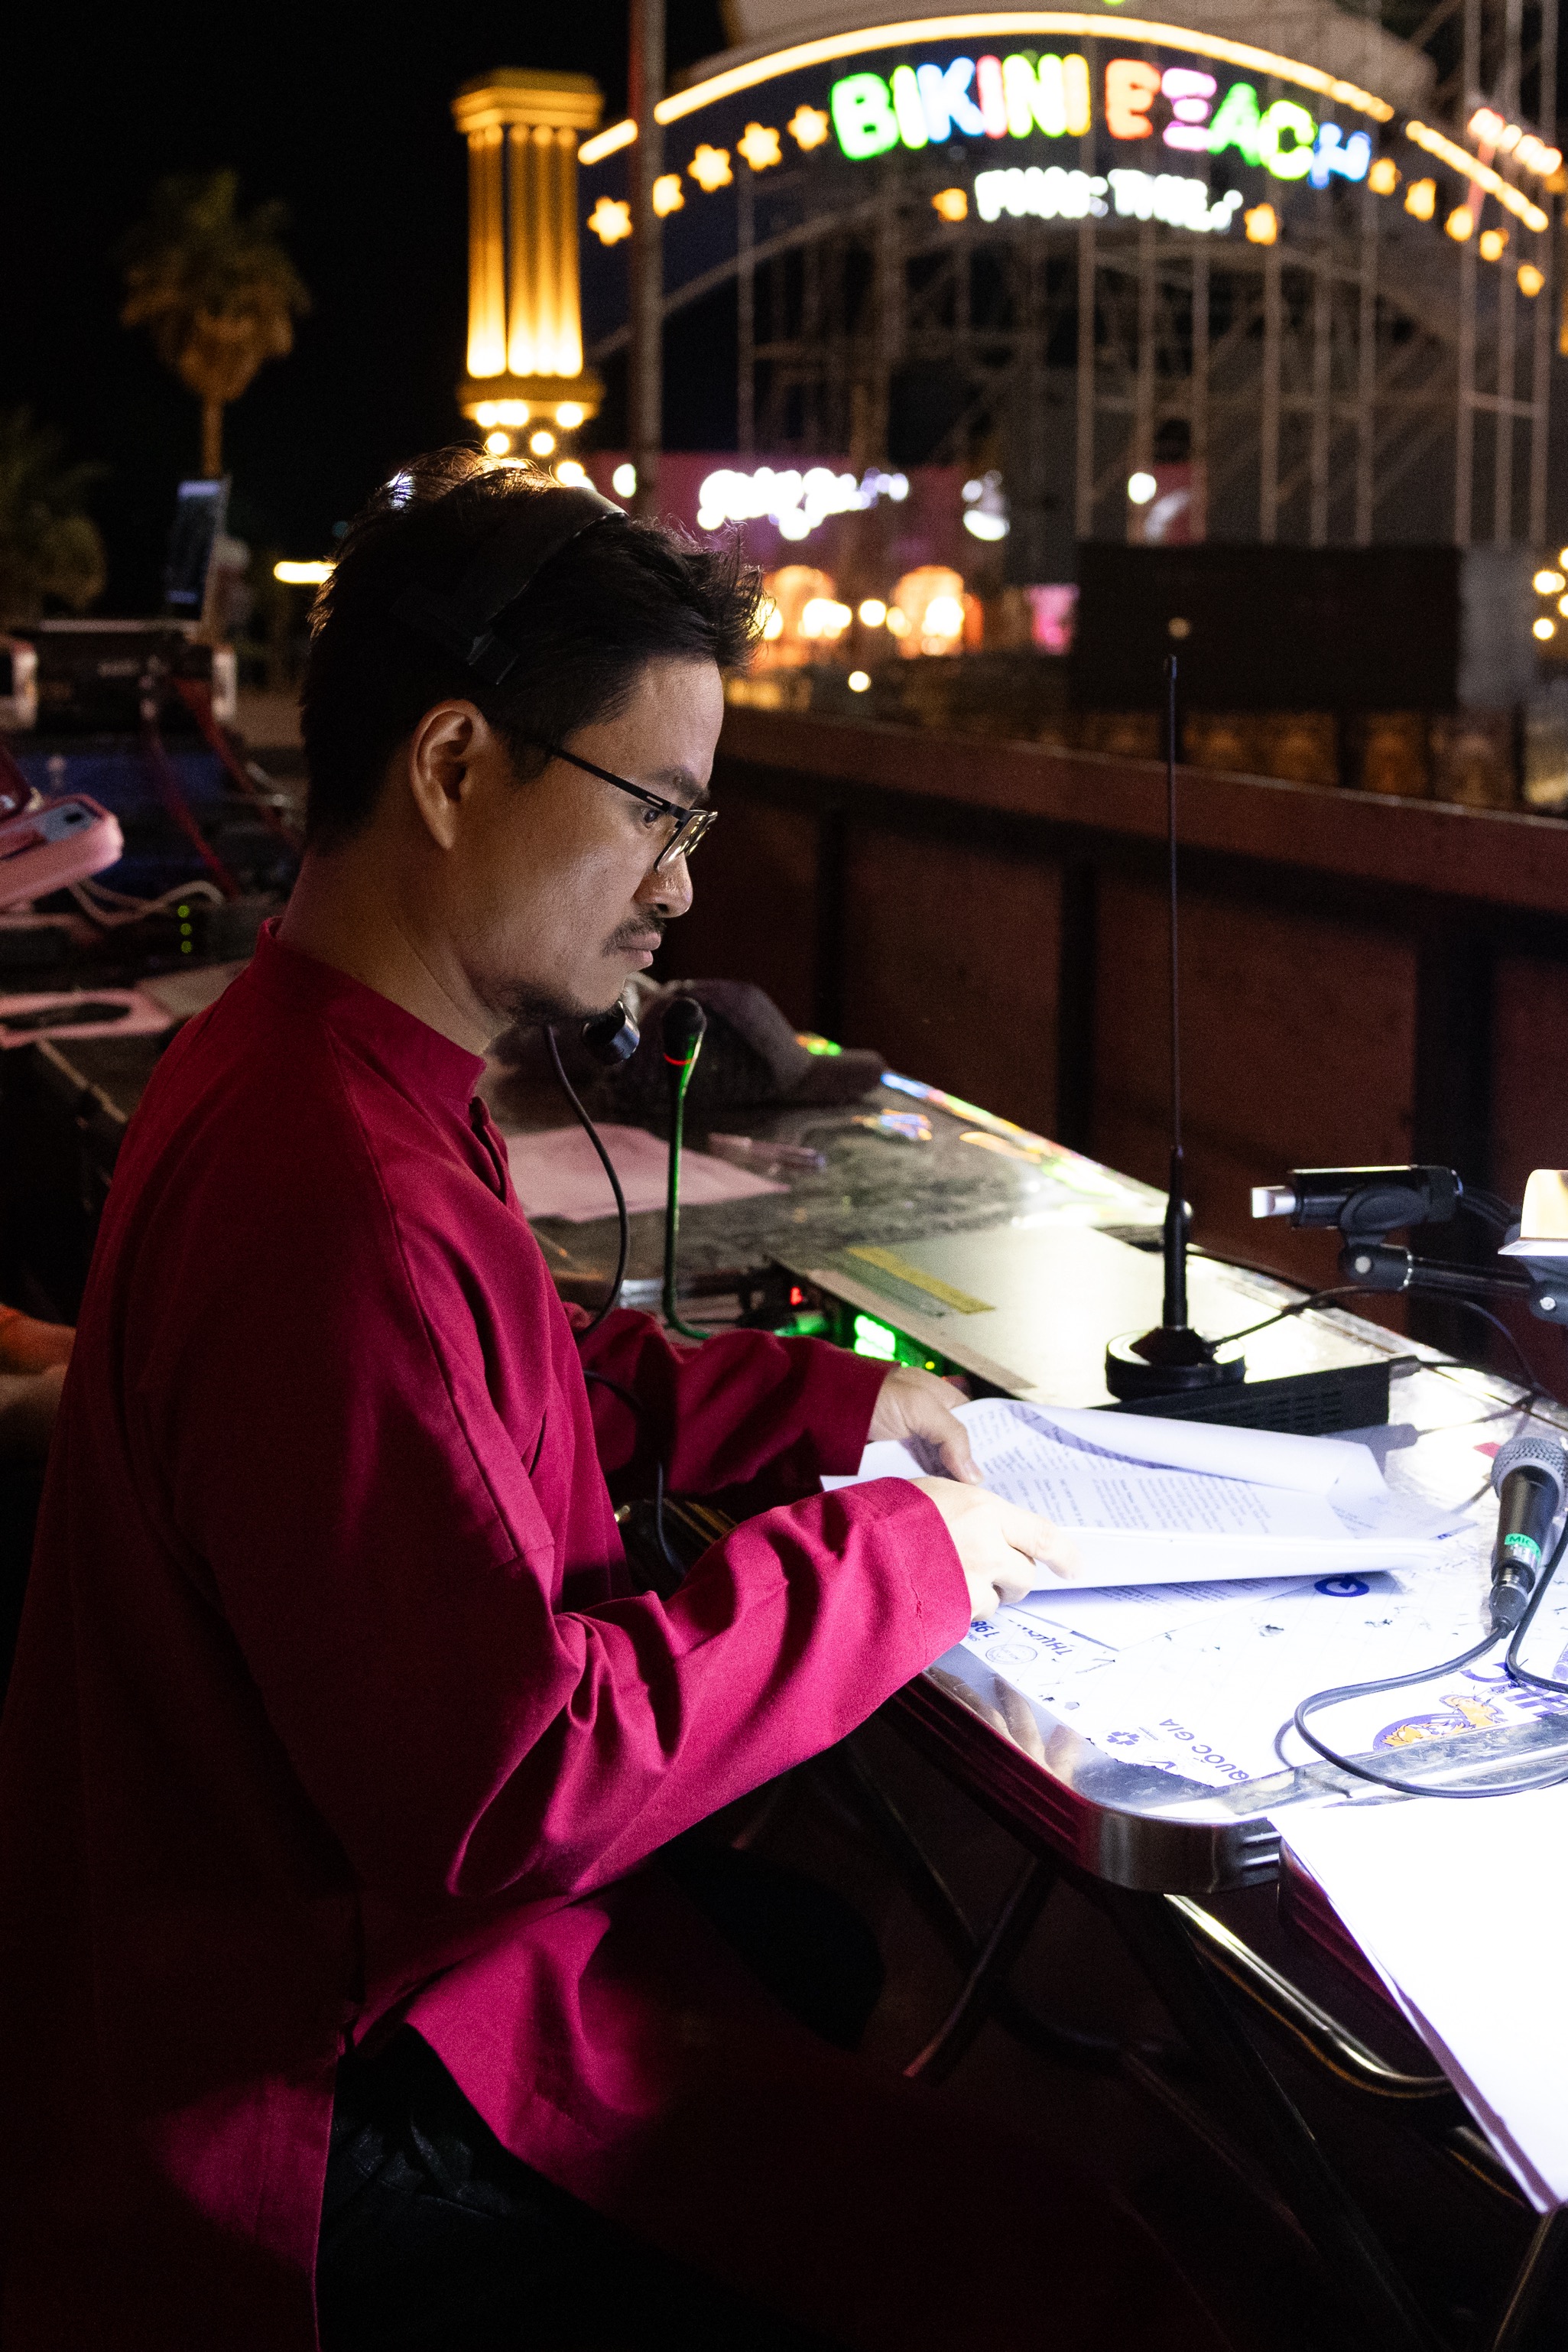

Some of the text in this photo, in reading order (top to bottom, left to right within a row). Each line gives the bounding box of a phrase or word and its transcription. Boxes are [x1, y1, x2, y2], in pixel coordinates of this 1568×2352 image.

[831, 54, 1091, 161] BIKINI
[1159, 1718, 1195, 1741] GIA
[1191, 1744, 1250, 1781] QUỐC
